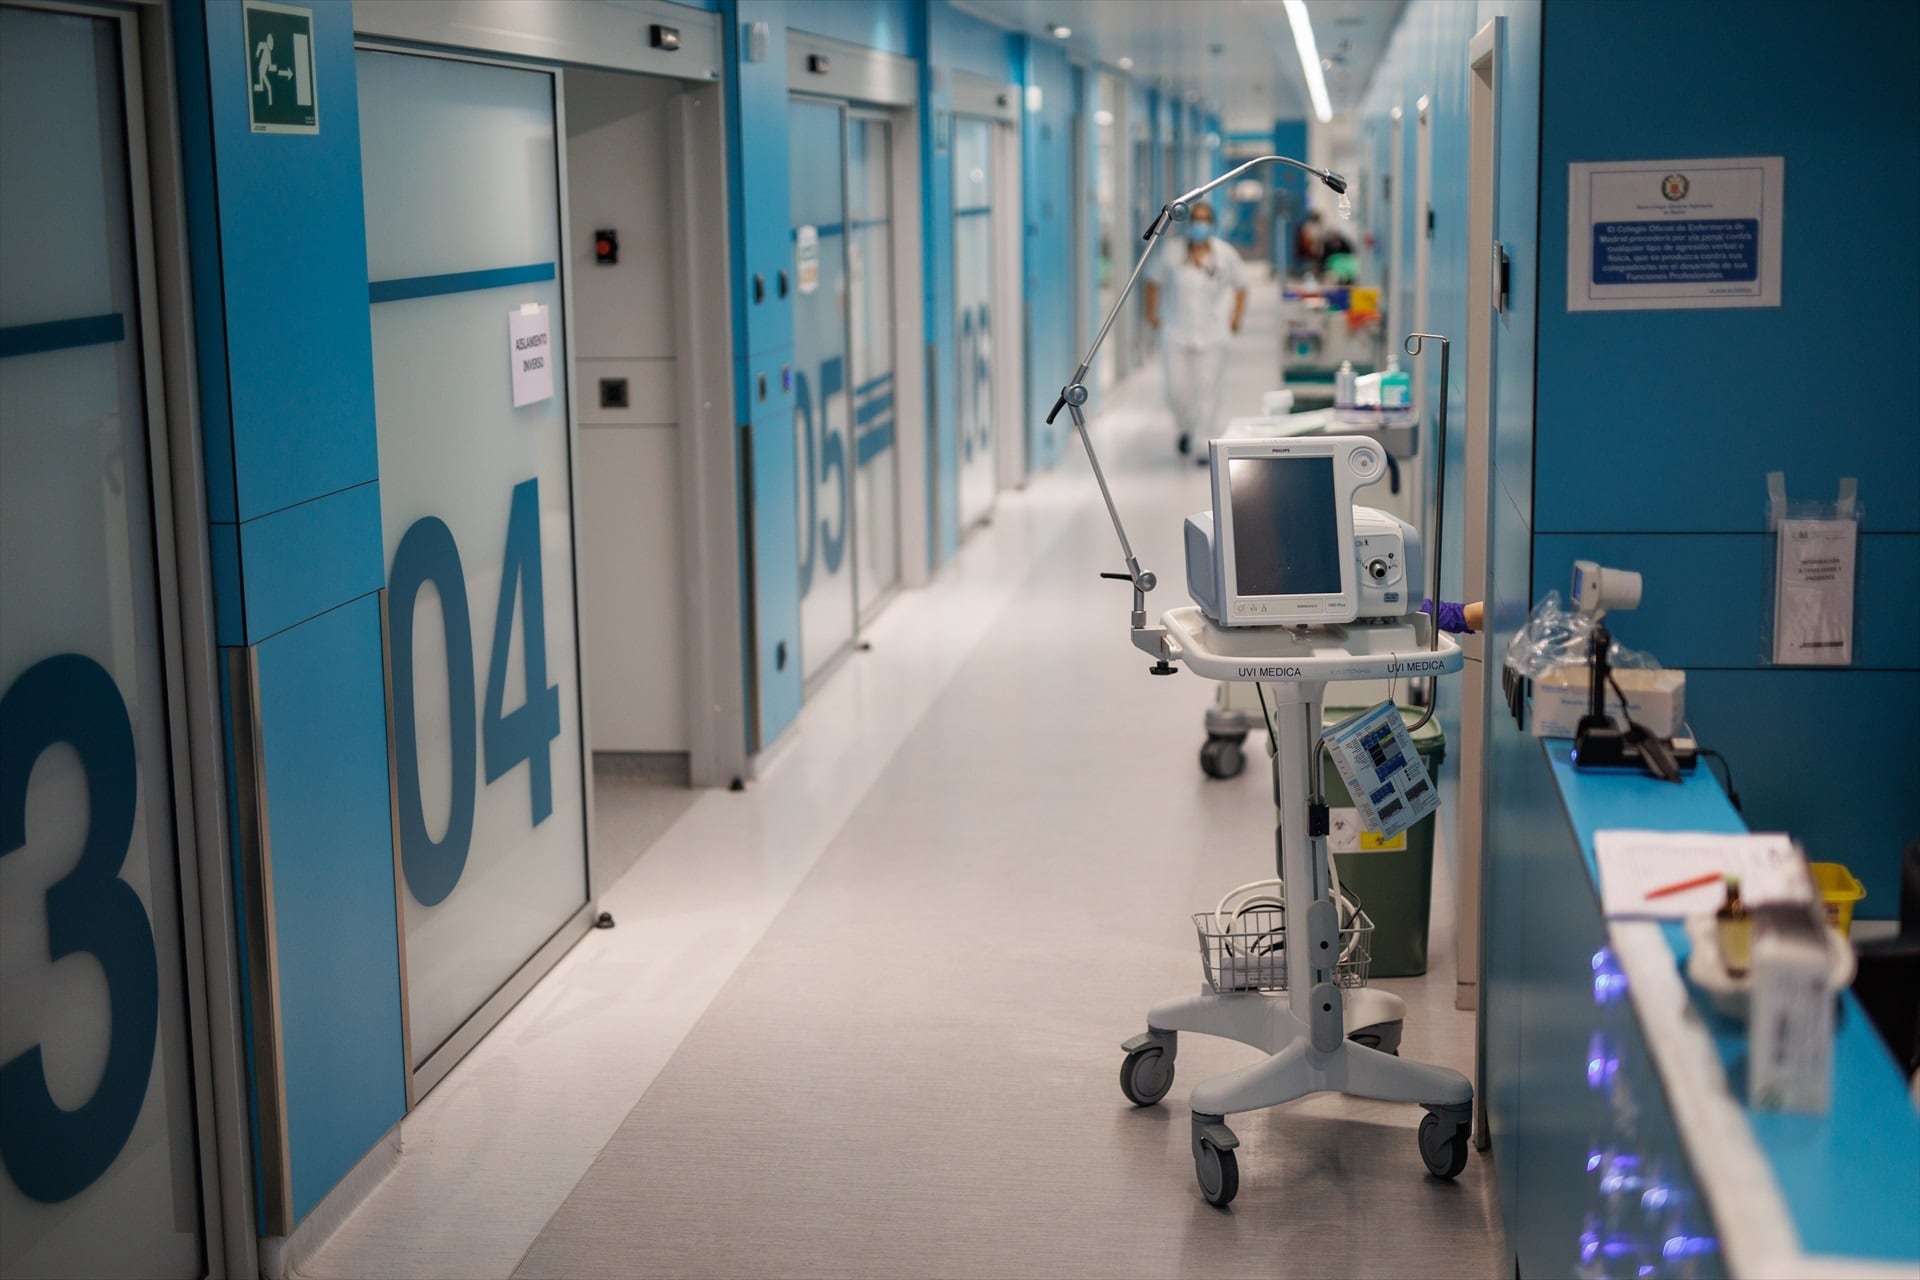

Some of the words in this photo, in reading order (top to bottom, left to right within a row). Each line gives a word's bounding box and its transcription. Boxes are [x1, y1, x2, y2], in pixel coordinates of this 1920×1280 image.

[1616, 225, 1648, 234] Colegio
[1648, 224, 1675, 232] Oficial
[1599, 235, 1629, 243] Madrid
[1672, 234, 1687, 243] por
[1725, 232, 1753, 240] contra
[1700, 252, 1727, 260] contra
[1387, 663, 1404, 673] UVI
[1407, 660, 1445, 671] MEDICA
[1238, 667, 1257, 677] UVI
[1259, 667, 1302, 677] MEDICA
[387, 477, 561, 907] 04
